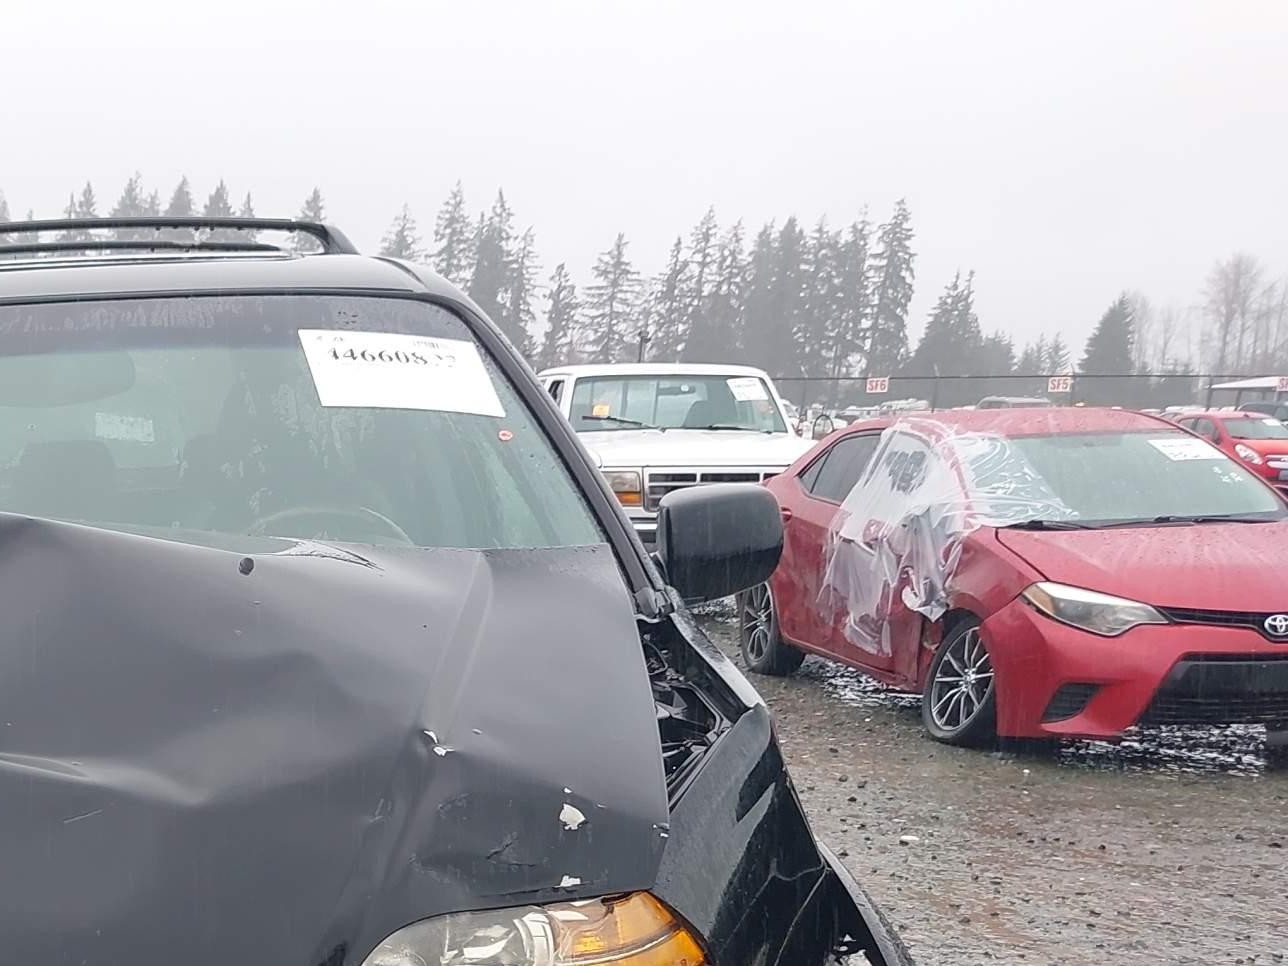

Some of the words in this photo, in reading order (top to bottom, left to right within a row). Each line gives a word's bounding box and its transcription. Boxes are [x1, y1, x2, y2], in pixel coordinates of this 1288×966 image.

[328, 347, 457, 368] 446608
[867, 379, 887, 391] SF6
[1050, 378, 1069, 390] SF5
